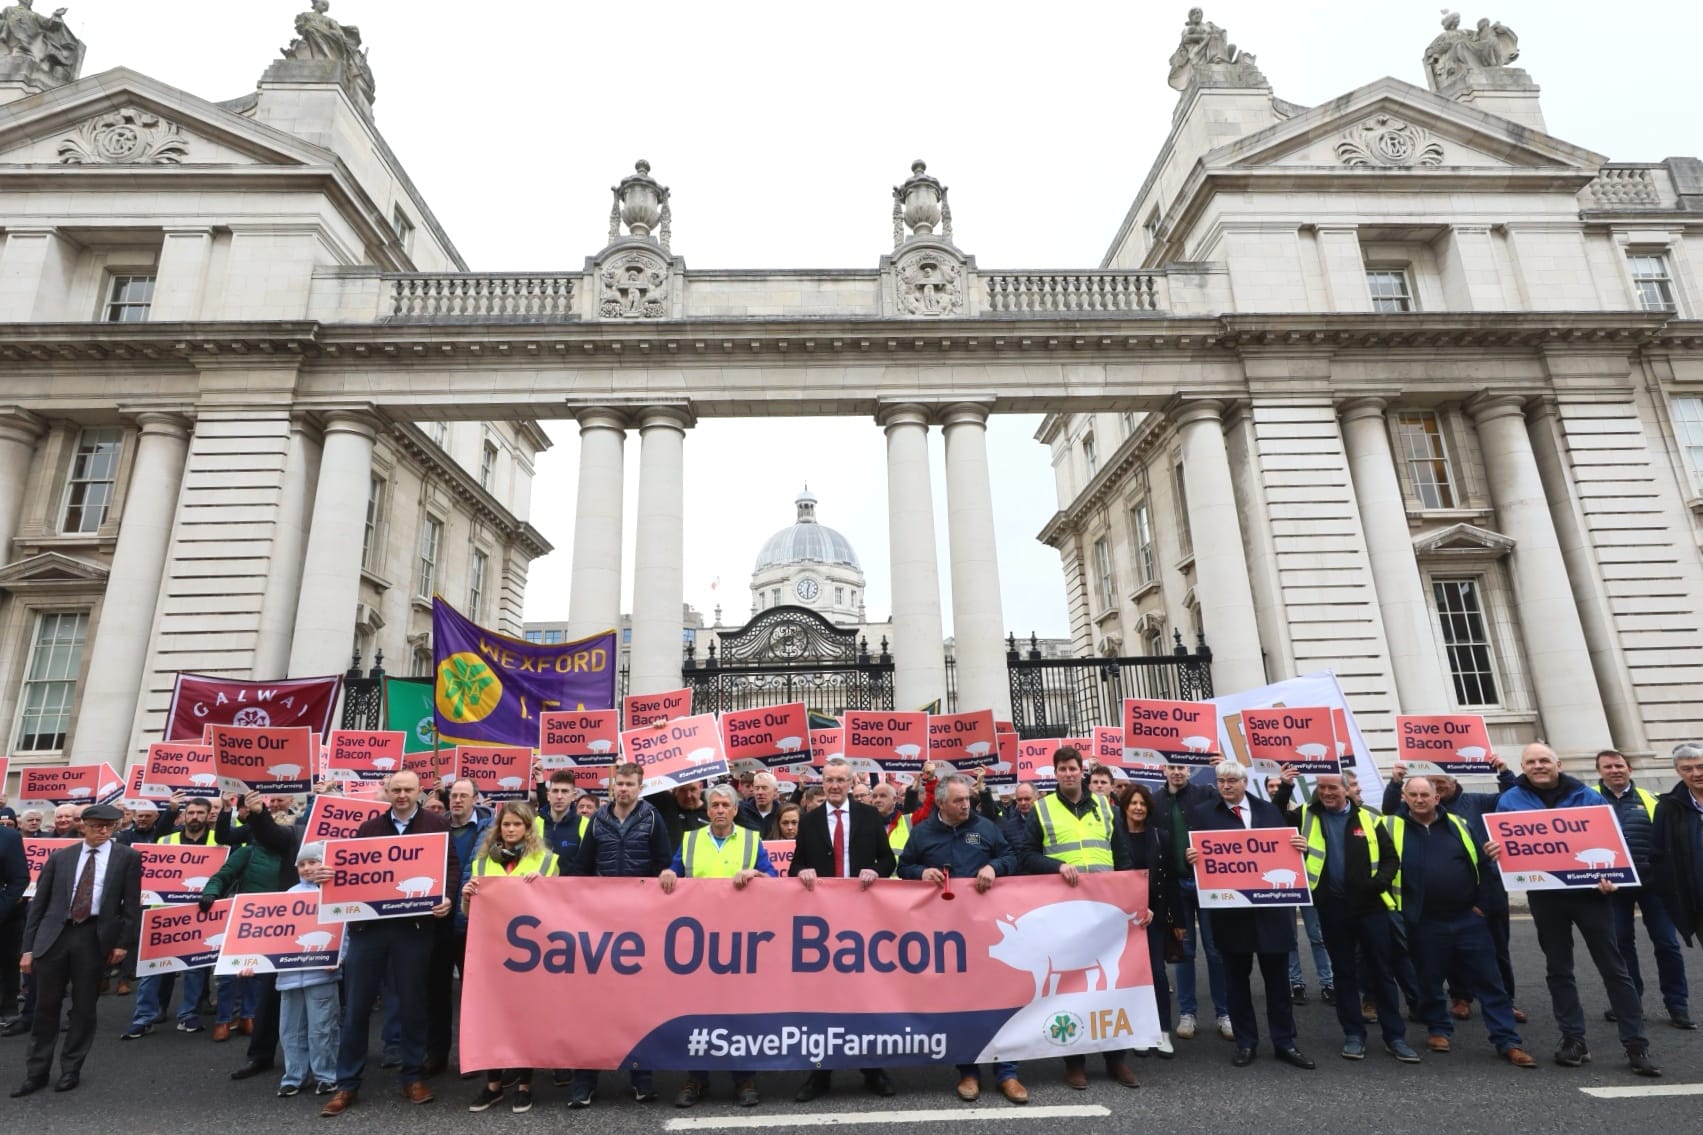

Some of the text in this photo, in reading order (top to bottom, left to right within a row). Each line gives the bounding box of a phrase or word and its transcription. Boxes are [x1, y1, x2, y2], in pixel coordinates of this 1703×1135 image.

[479, 637, 607, 673] WEXFORD
[631, 698, 682, 713] Save Our
[1132, 706, 1200, 722] Save Our
[547, 717, 603, 730] Save Our
[729, 713, 790, 732] Save Our
[851, 718, 912, 731] Save Our
[929, 720, 979, 734] ave Our
[1248, 715, 1312, 730] Save Our
[1403, 721, 1471, 734] Save Our
[1133, 722, 1179, 738] Bacon
[218, 733, 288, 750] Save Our
[337, 736, 391, 747] Save Our
[547, 732, 586, 744] Bacon
[631, 725, 699, 751] Save Our
[730, 732, 773, 748] Bacon
[819, 735, 838, 744] Our
[851, 733, 893, 746] Bacon
[1100, 732, 1123, 743] Sav
[1251, 733, 1292, 747] Bacon
[1405, 737, 1453, 749] Bacon
[1026, 746, 1048, 756] Our
[1074, 742, 1092, 751] Our
[1100, 745, 1122, 756] Bac
[154, 750, 213, 762] Save Our
[220, 751, 264, 766] Bacon
[335, 749, 371, 759] Bacon
[461, 753, 517, 765] Save Our
[635, 747, 682, 767] Bacon
[152, 763, 189, 775] Bacon
[402, 758, 427, 769] Save
[28, 771, 85, 782] Save Our
[461, 766, 497, 779] Bacon
[27, 782, 66, 792] Bacon
[321, 804, 363, 822] Save
[317, 822, 358, 839] Baco
[1498, 818, 1590, 837] Save Our
[26, 845, 56, 857] Sav
[1201, 838, 1279, 855] Save Our
[1504, 840, 1570, 857] Bacon
[140, 851, 209, 864] Save Our
[334, 845, 424, 867] Save Our
[770, 851, 794, 862] ave
[1204, 859, 1258, 874] Bacon
[333, 870, 394, 887] Bacon
[1528, 874, 1545, 883] IFA
[242, 900, 319, 919] Save Ou
[346, 906, 360, 914] IFA
[151, 909, 227, 930] Save Our
[150, 929, 202, 946] Bacon
[237, 923, 296, 939] Bacon
[503, 915, 967, 975] Save Our Bacon
[1090, 1008, 1134, 1040] IFA
[687, 1026, 947, 1062] #SavePigFarming
